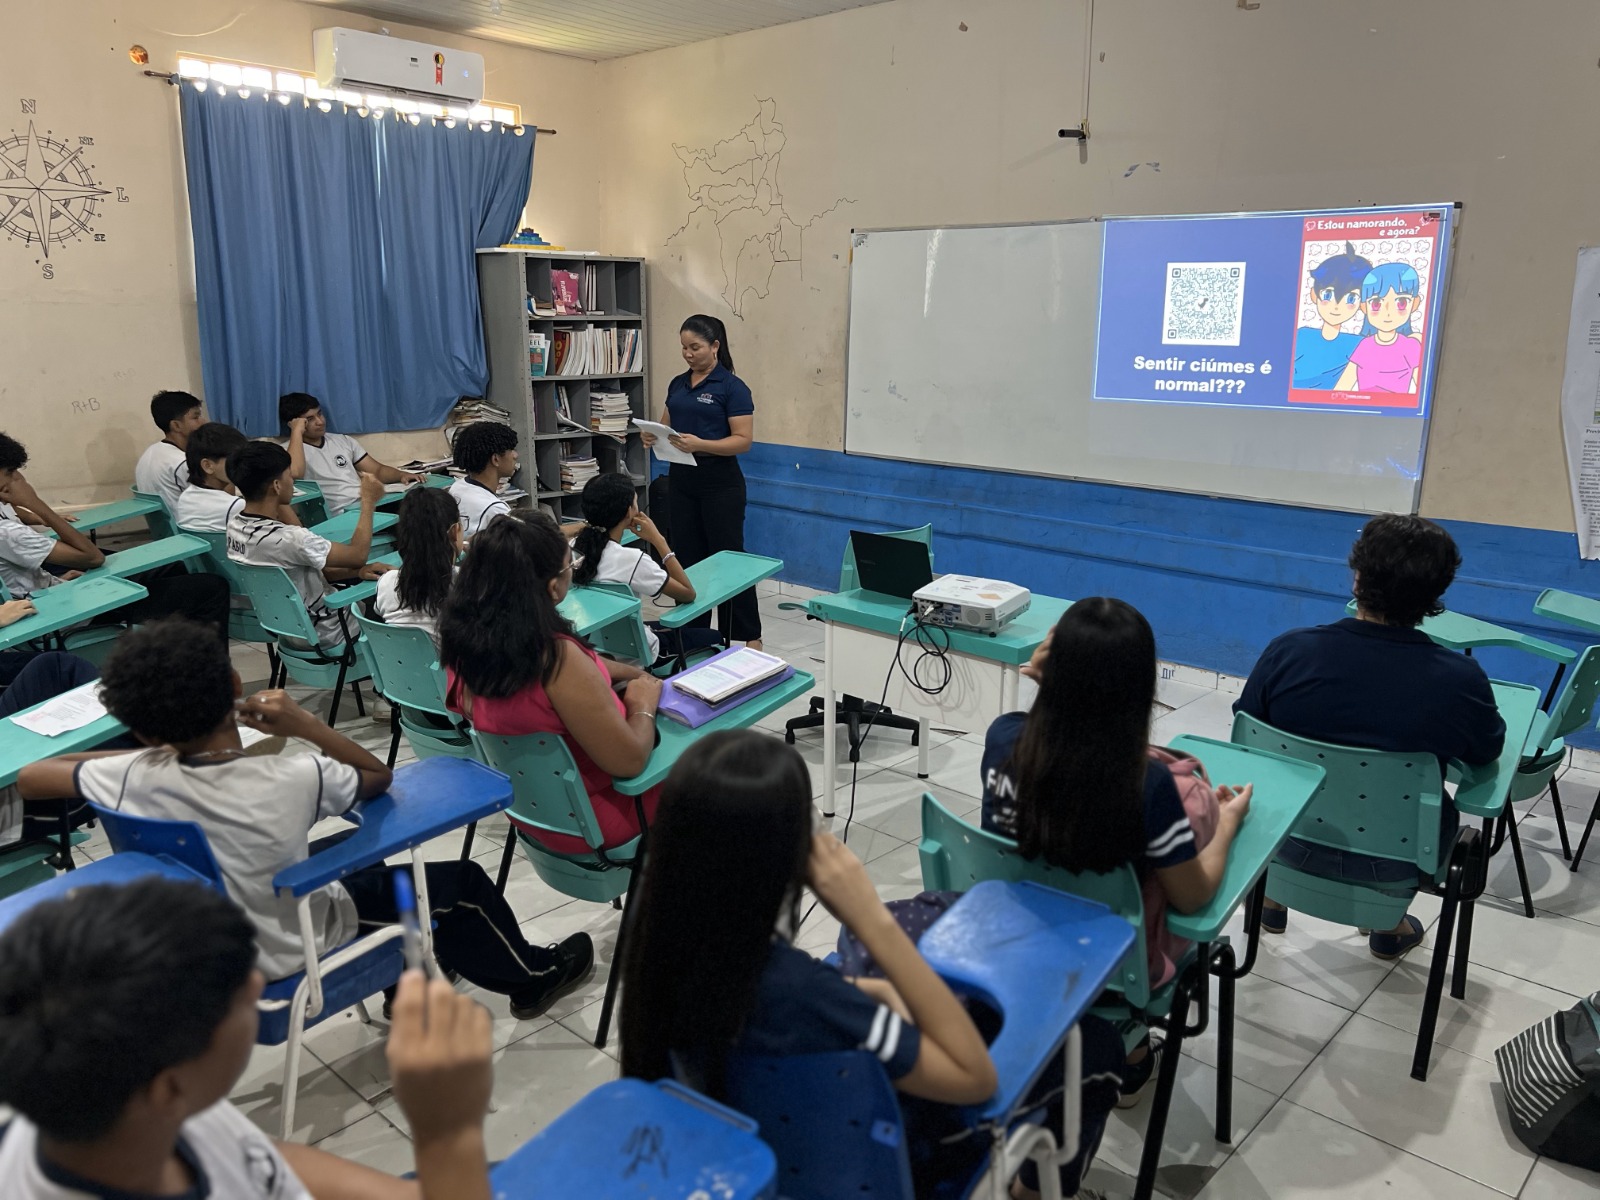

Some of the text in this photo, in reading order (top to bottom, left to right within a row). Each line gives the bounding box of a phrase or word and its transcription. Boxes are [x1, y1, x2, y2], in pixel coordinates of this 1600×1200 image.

[21, 99, 36, 114] N
[79, 136, 94, 146] NE
[116, 187, 129, 202] L
[1317, 220, 1344, 230] Estou
[1387, 226, 1421, 238] agora?
[42, 264, 54, 279] S
[1133, 356, 1273, 375] Sentir ciúmes é
[1154, 378, 1247, 394] normal???
[228, 536, 246, 555] PABLO
